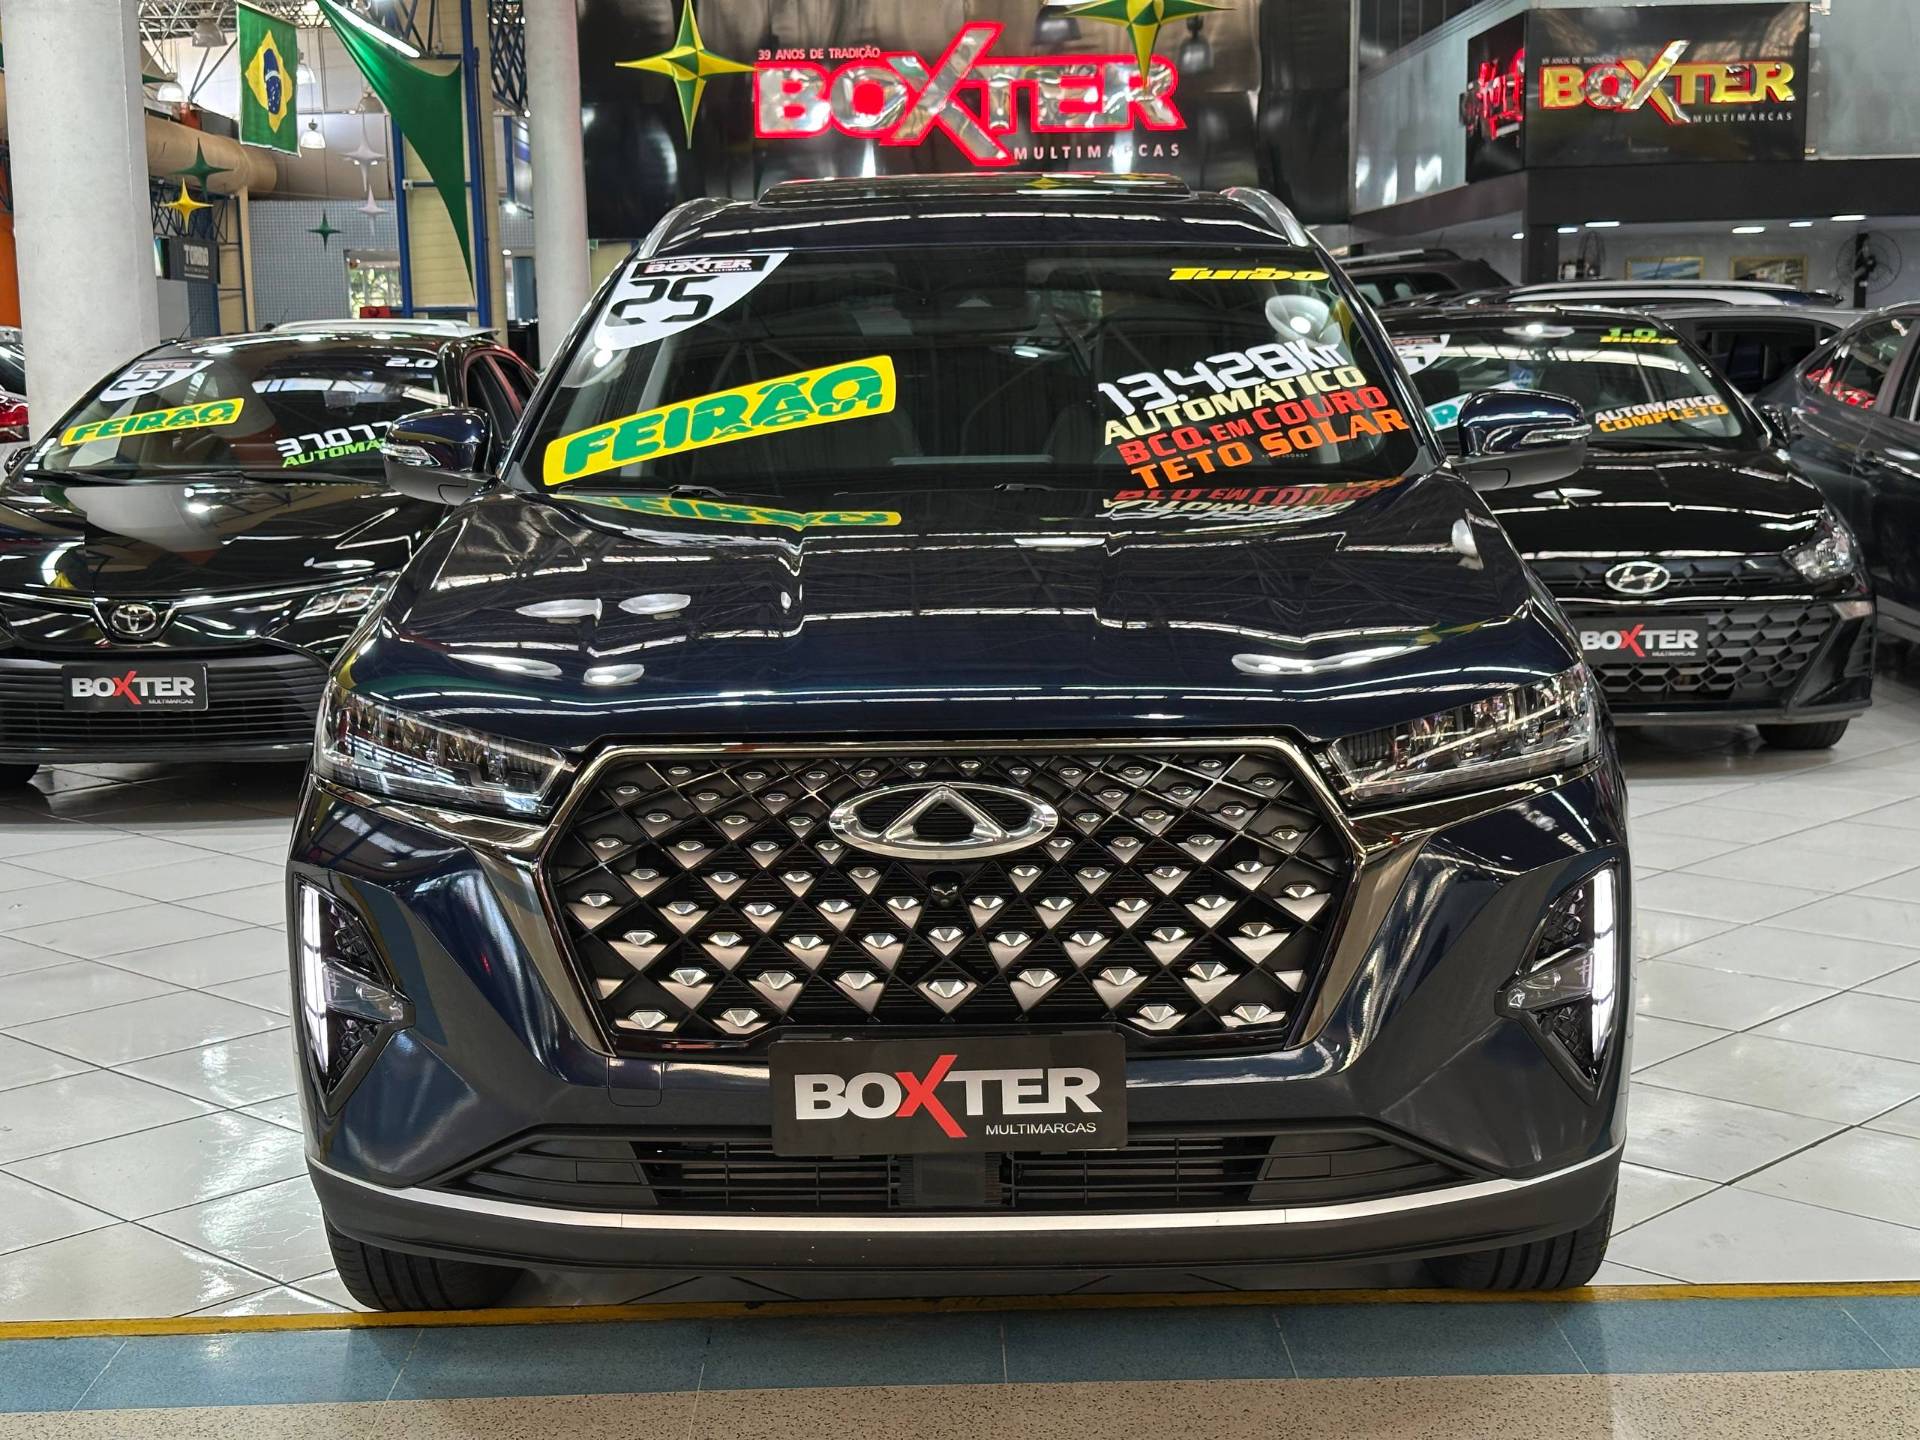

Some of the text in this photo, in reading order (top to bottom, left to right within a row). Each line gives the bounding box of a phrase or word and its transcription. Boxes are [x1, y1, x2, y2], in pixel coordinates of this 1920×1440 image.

[758, 45, 880, 60] 39 ANOS DE TRADIÇÃO
[753, 21, 1187, 166] BOXTER
[1539, 39, 1797, 127] BOXTER
[1692, 111, 1793, 124] MULTIMARCAS
[1014, 144, 1180, 160] MULTIMARCAS
[643, 257, 753, 274] BOXTER
[1168, 267, 1331, 282] Turbo
[604, 275, 721, 328] 25
[1608, 327, 1657, 337] 1.0
[385, 357, 439, 369] 2.0
[71, 402, 236, 443] FEIRÃO
[562, 365, 882, 475] FEIRÃO
[1210, 418, 1253, 442] EM
[1251, 386, 1389, 430] COURO
[1599, 404, 1729, 432] COMPLETO
[1131, 441, 1252, 489] TETO
[1259, 409, 1409, 457] SOLAR
[1579, 624, 1699, 658] BOXTER
[71, 670, 196, 705] BOXTER
[794, 1054, 1103, 1138] BOXTER
[985, 1122, 1097, 1136] MULTIMARCAS
